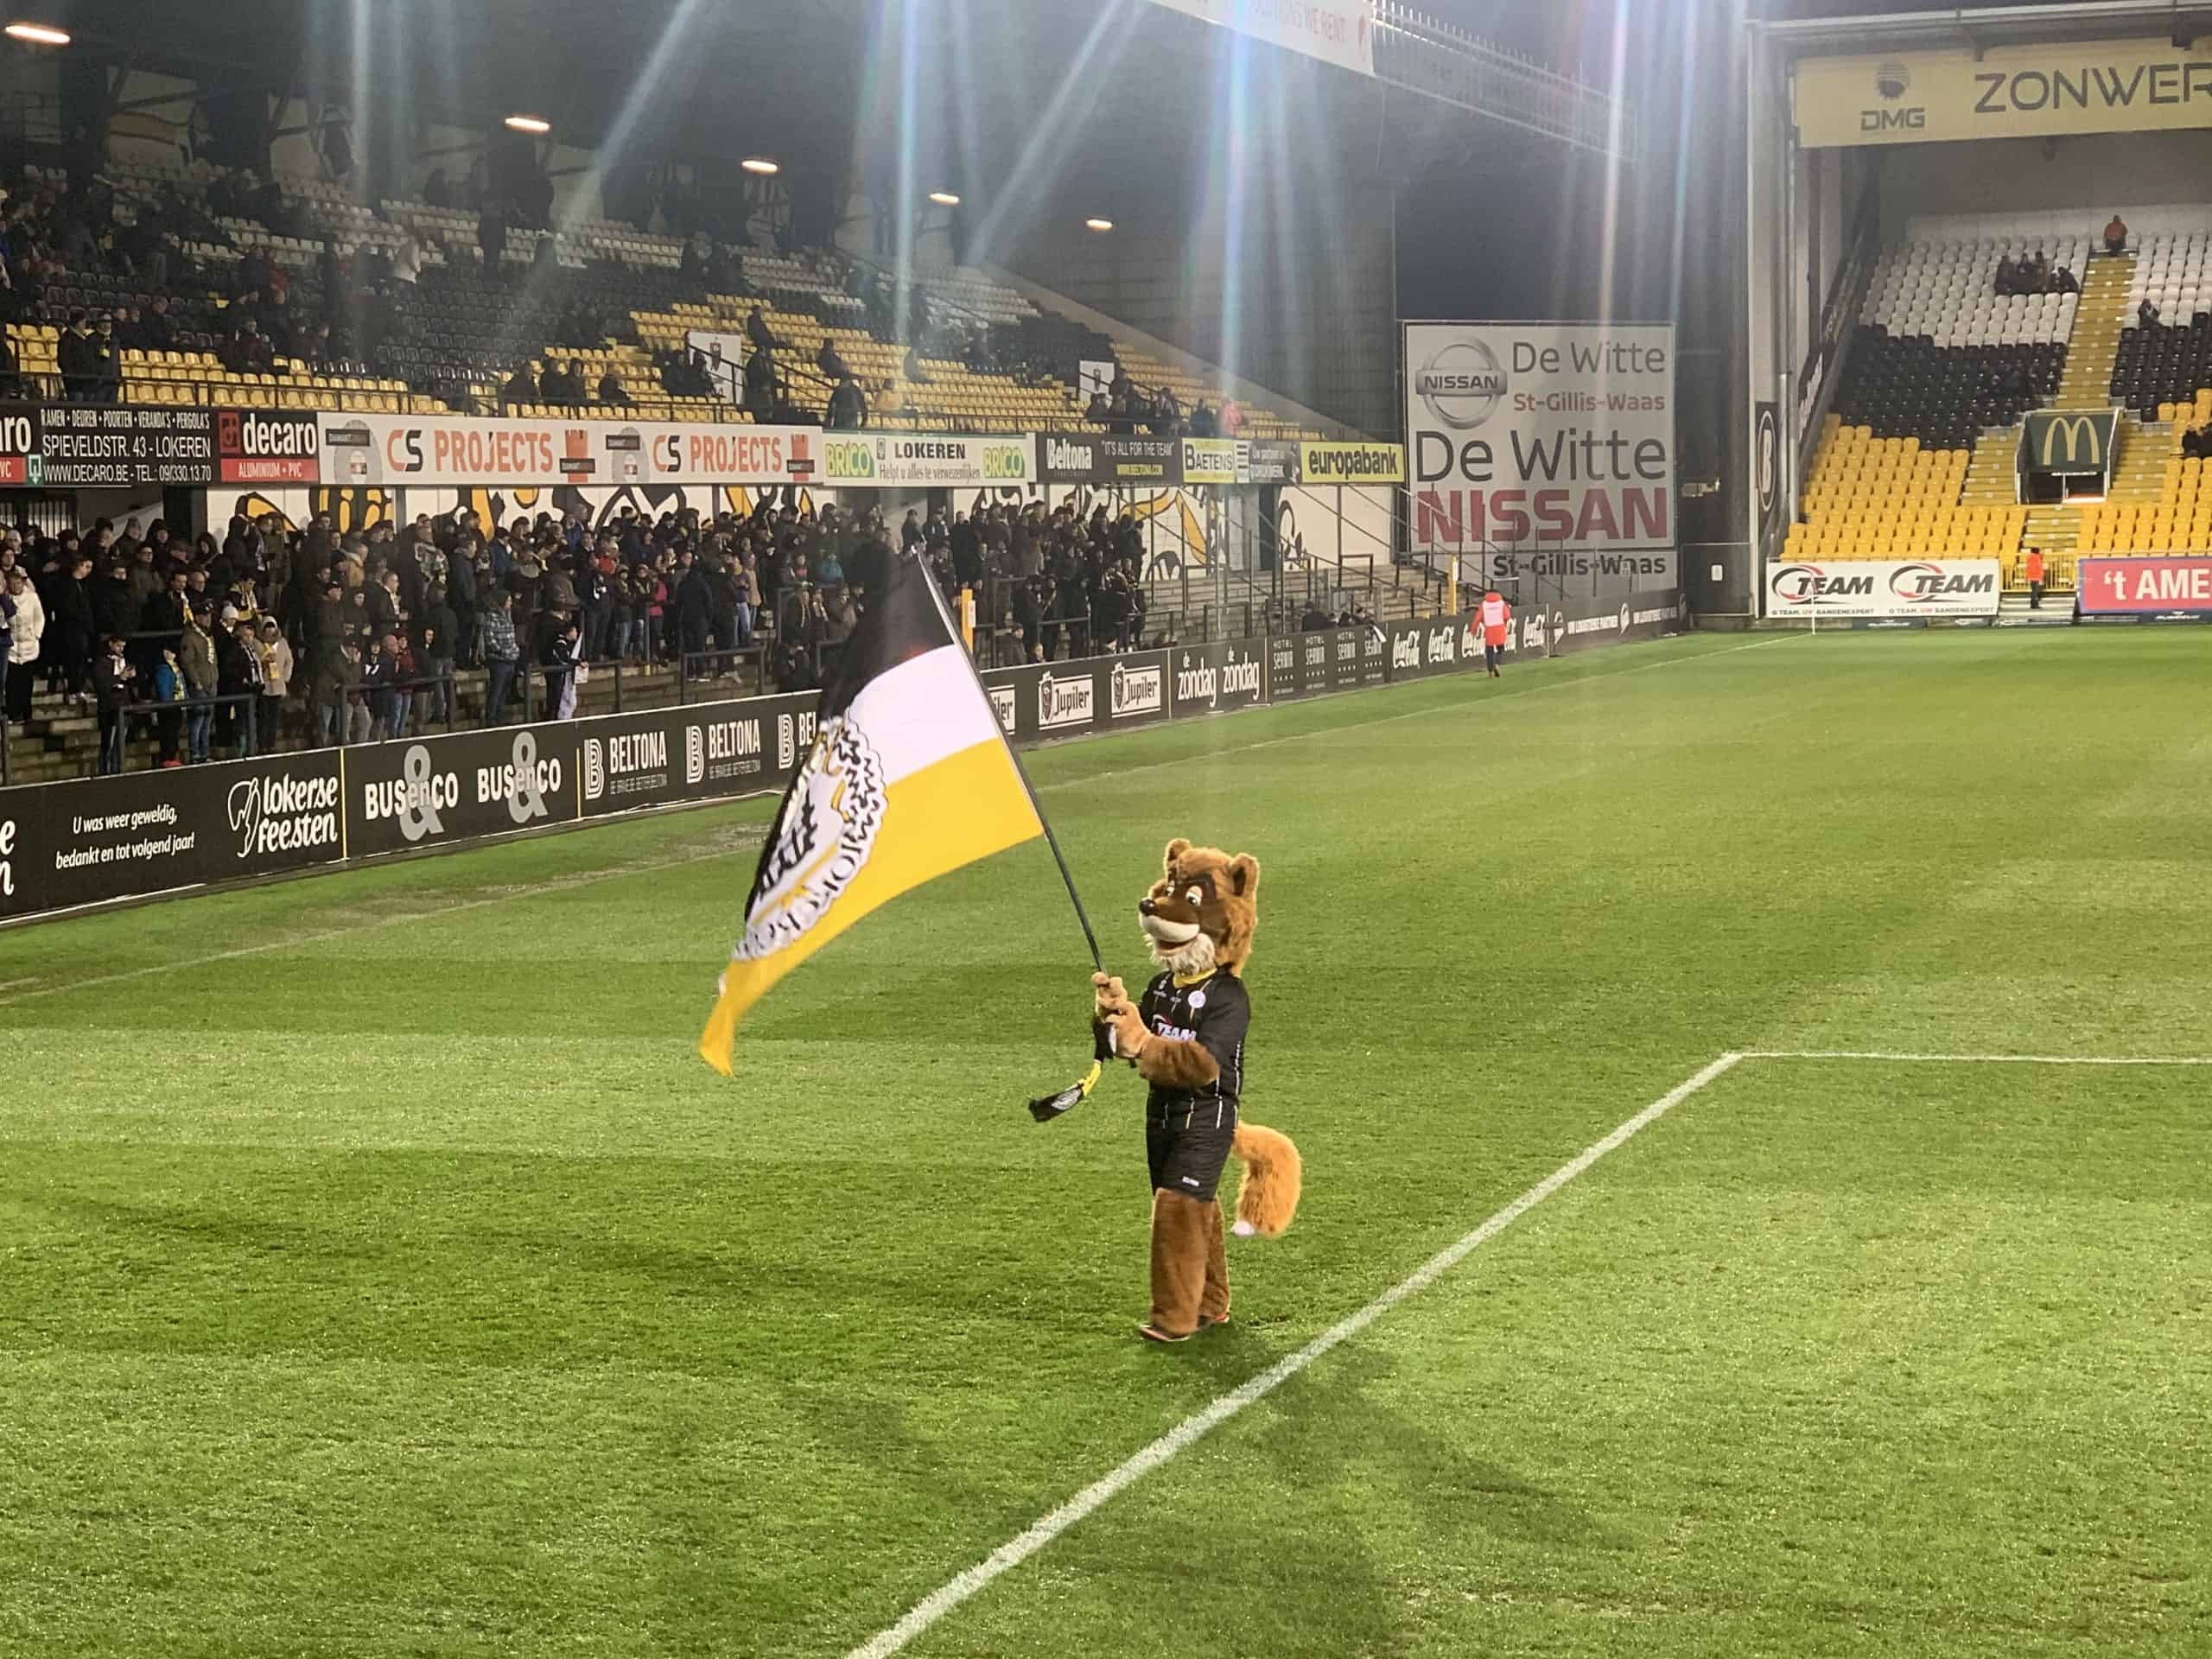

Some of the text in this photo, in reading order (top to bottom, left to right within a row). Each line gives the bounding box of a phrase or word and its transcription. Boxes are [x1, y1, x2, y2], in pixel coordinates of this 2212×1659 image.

[1974, 62, 2212, 113] ZONWER
[1861, 107, 1925, 130] DMG
[1513, 341, 1666, 373] De Witte
[1425, 375, 1498, 389] NISSAN
[1513, 392, 1665, 411] St-Gillis-Waas
[41, 408, 66, 427] RAMEN
[103, 410, 132, 428] POORTEN
[243, 413, 317, 455] decaro
[0, 416, 31, 453] ro
[42, 435, 130, 457] SPIEVELDSTR.
[133, 435, 147, 457] 43
[156, 435, 211, 458] LOKEREN
[894, 442, 966, 459] LOKEREN
[1129, 442, 1142, 456] FOR
[387, 429, 553, 473] CS PROJECTS
[653, 435, 782, 473] CS PROJECTS
[824, 440, 871, 476] BRICO
[982, 444, 1024, 477] BRICO
[1046, 438, 1093, 470] Beltona
[1185, 444, 1232, 470] BAETENS
[1309, 446, 1398, 479] europabank
[1416, 429, 1667, 482] De Witte
[43, 463, 129, 482] WWW.DECARO.BE
[238, 462, 302, 479] ALUMINIUM PVC
[1417, 487, 1668, 543] NISSAN
[1798, 576, 1873, 595] TEAM
[1914, 574, 1993, 594] TEAM
[2135, 569, 2209, 601] AME
[1126, 677, 1158, 706] Jupiler
[1178, 657, 1216, 708] zondag
[1223, 652, 1260, 700] zondag
[1054, 685, 1090, 716] Jupiler
[609, 731, 667, 774] BELTONA
[709, 719, 761, 760] BELTONA
[73, 804, 177, 834] U was weer geweldig,
[55, 832, 194, 869] bedankt en tot volgend jaar!
